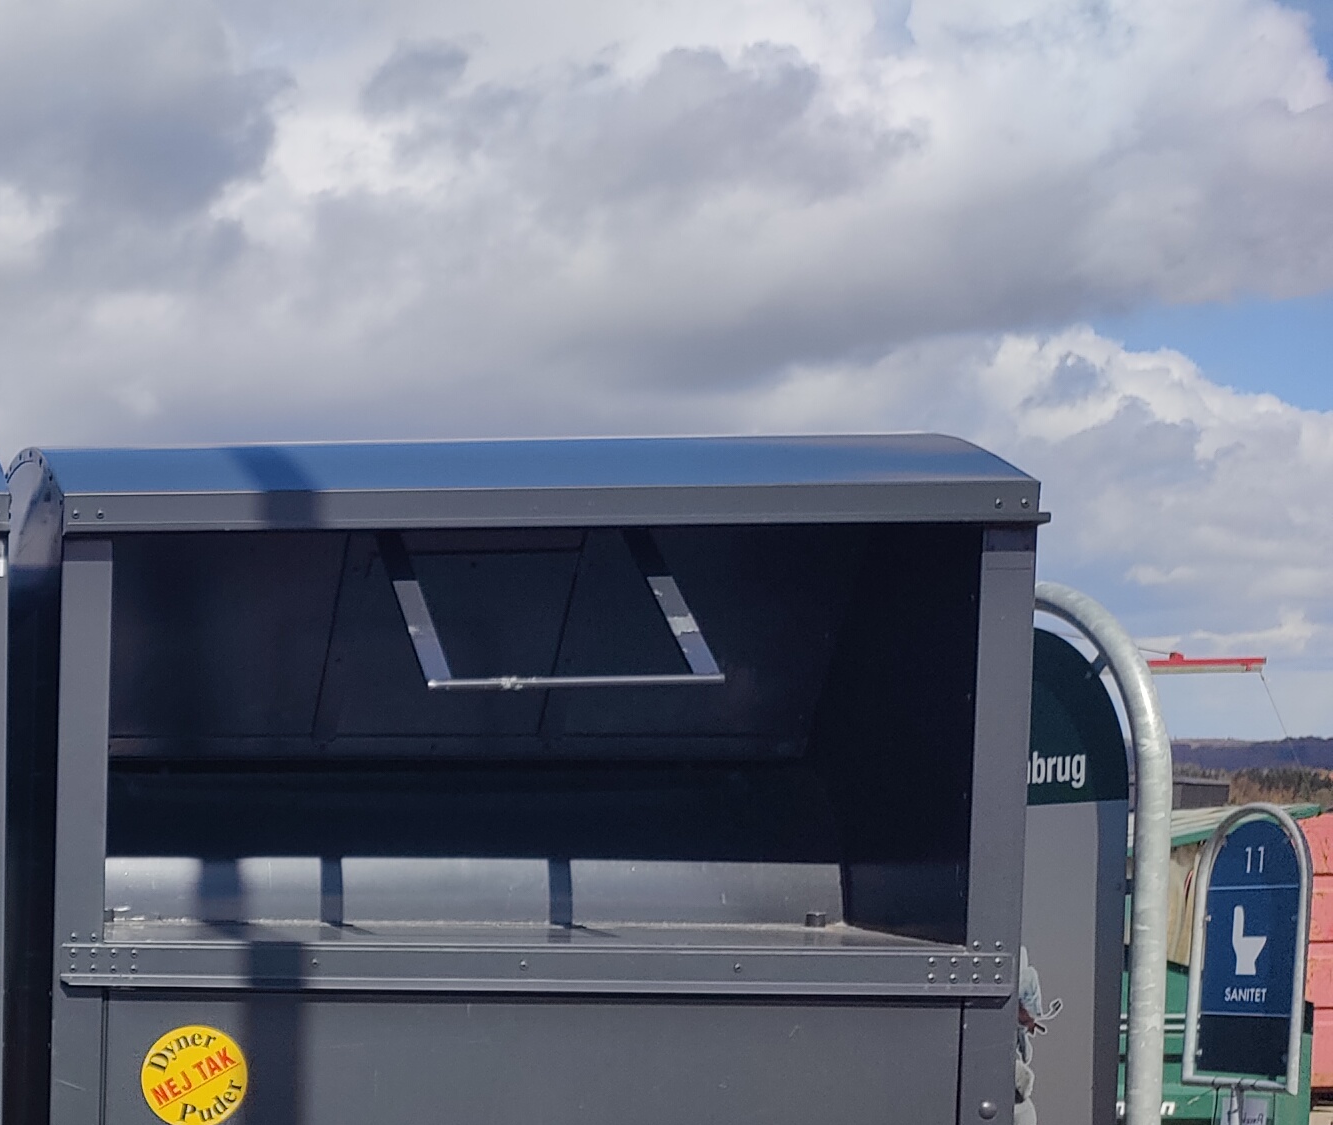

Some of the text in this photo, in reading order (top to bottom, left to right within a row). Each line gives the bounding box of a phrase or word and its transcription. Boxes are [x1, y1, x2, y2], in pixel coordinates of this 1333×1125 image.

[1245, 846, 1264, 873] 11
[1225, 987, 1267, 1003] SANITET
[146, 1032, 217, 1075] Dyner
[150, 1046, 236, 1106] NEJ TAK
[177, 1079, 242, 1123] Puder
